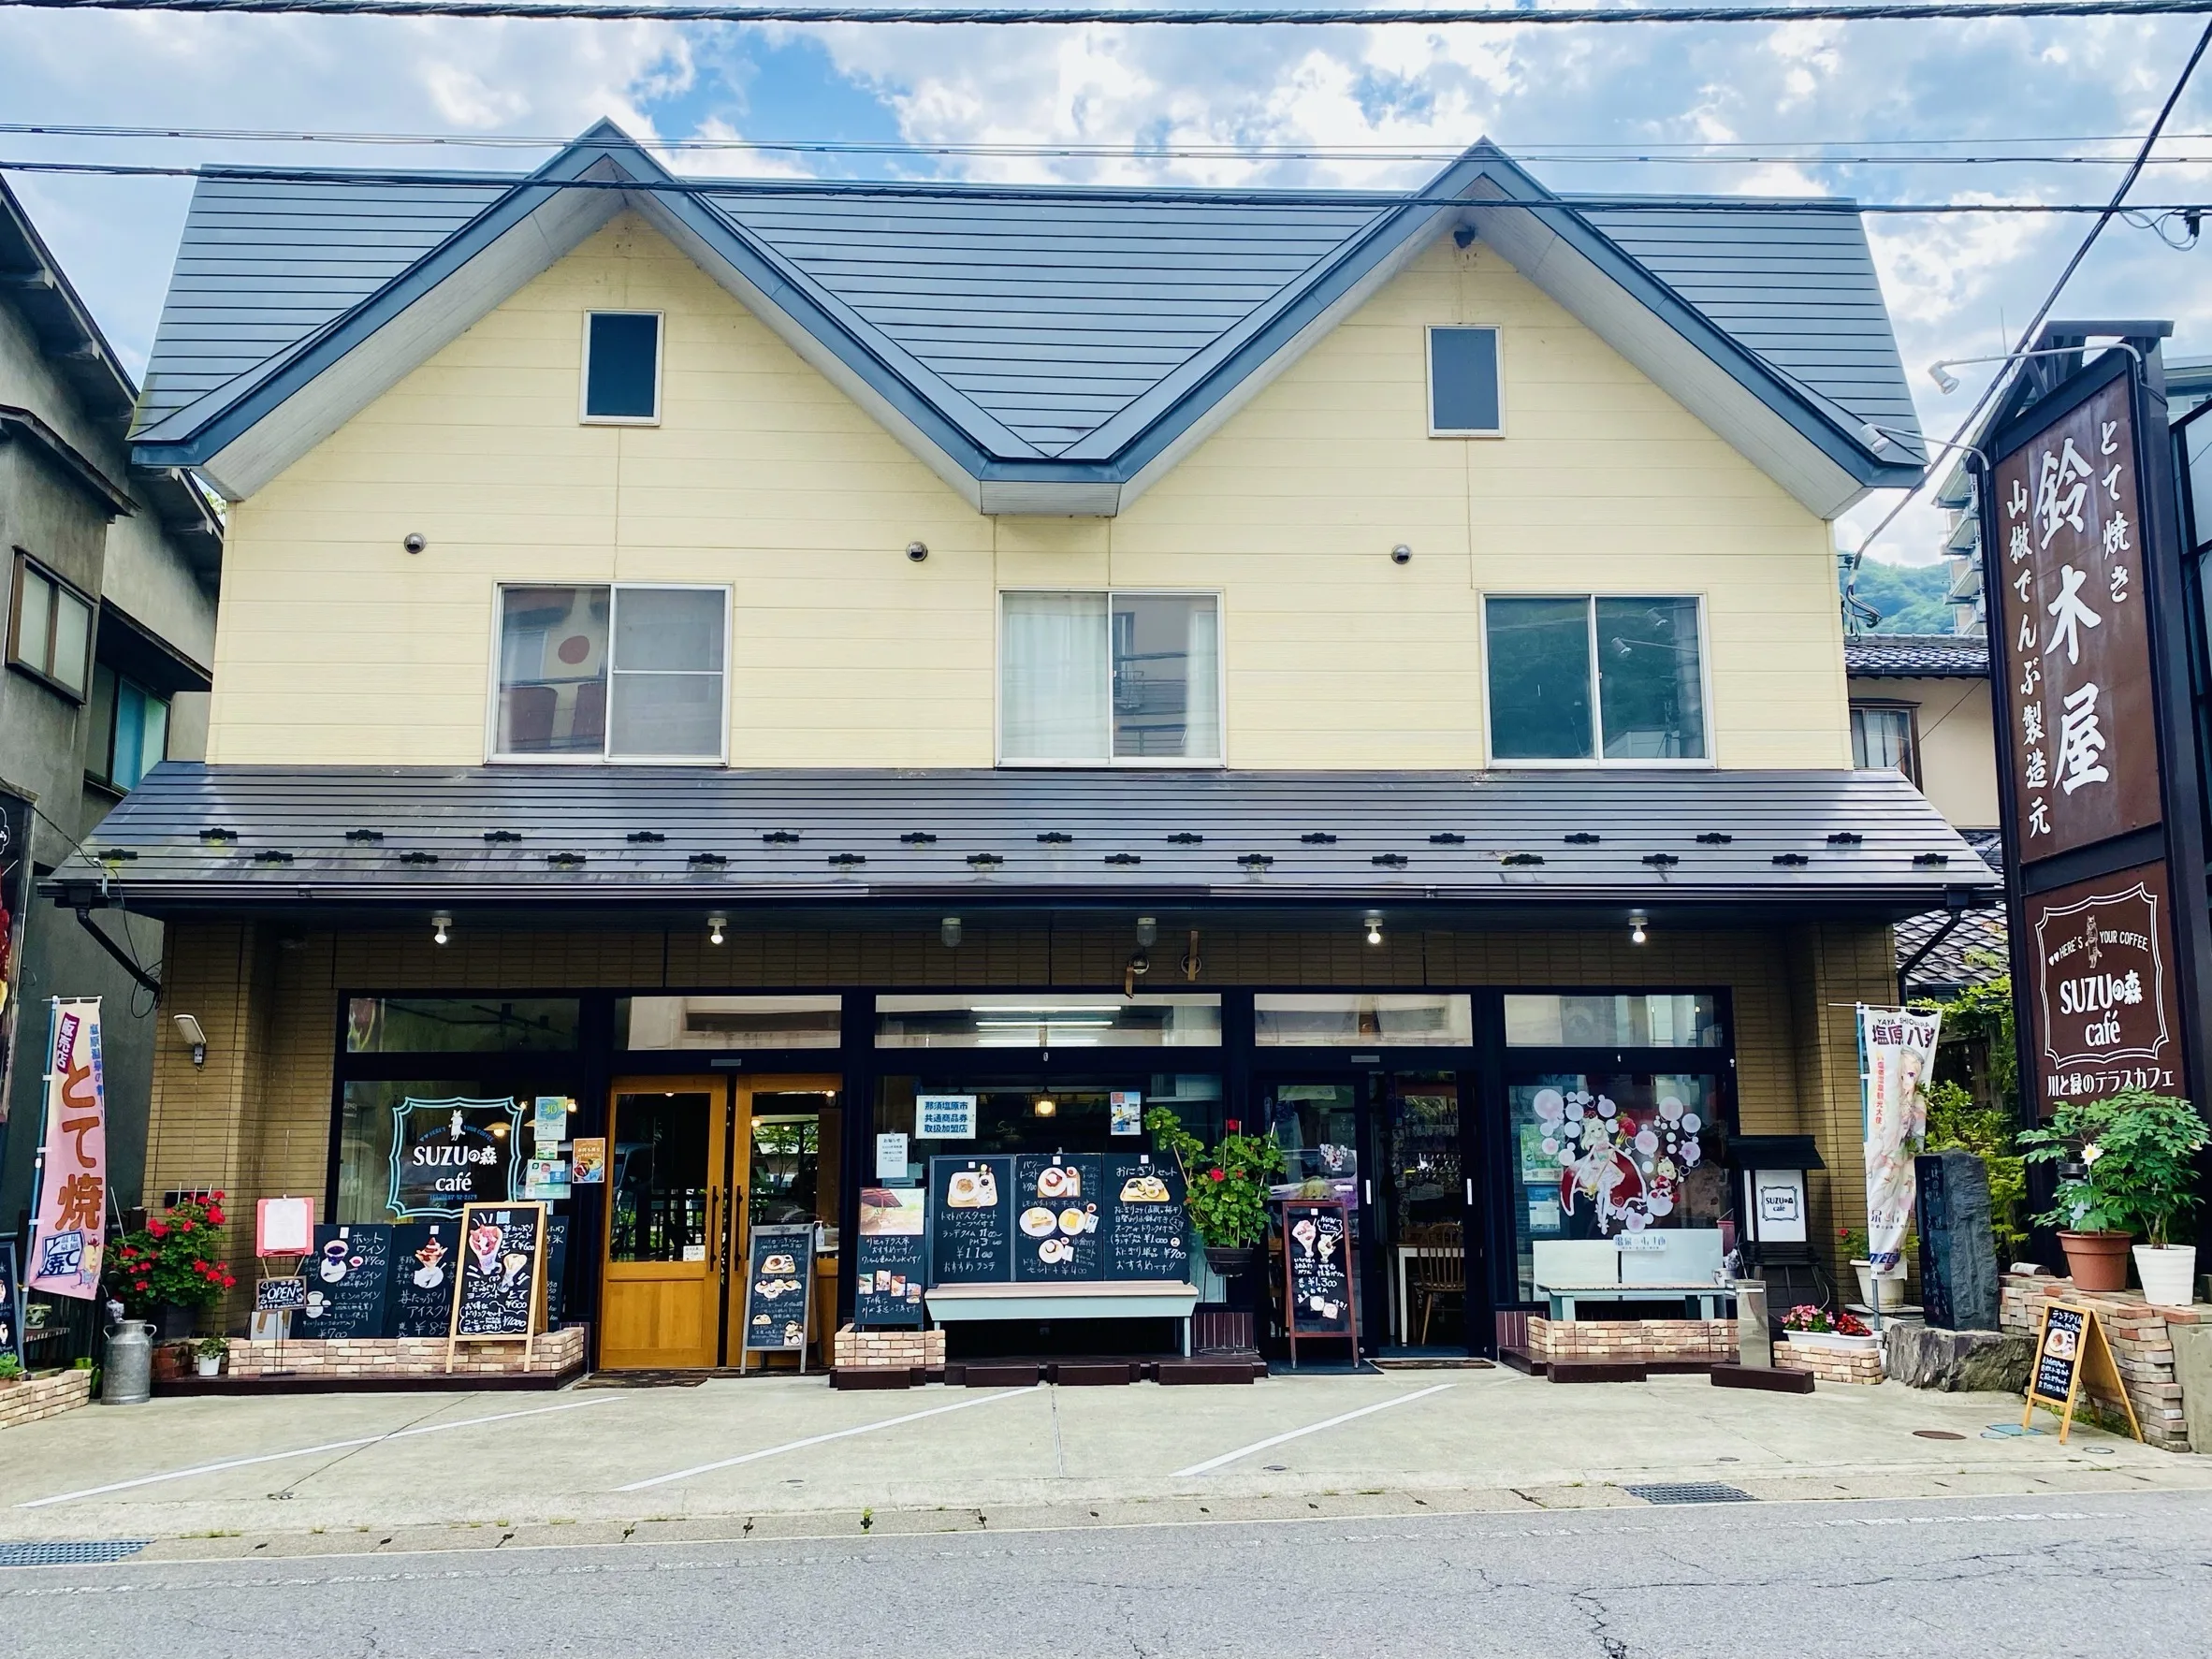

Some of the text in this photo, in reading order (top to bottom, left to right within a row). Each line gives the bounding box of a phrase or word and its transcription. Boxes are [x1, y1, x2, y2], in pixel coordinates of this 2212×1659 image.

[2100, 420, 2132, 604] とて焼き
[2034, 436, 2110, 796] 鈴木屋
[2099, 930, 2117, 944] YOUR
[2085, 1010, 2121, 1047] café
[2047, 1067, 2175, 1097] 川と緑のテラスカフェ
[924, 1101, 968, 1110] 那須塩原市
[924, 1113, 968, 1123] 共通商品券
[924, 1124, 968, 1133] 取扱加盟店
[412, 1145, 498, 1166] SUZUの森
[435, 1171, 473, 1191] café
[353, 1231, 384, 1244] ホット
[357, 1244, 386, 1255] ワイン
[267, 1287, 297, 1299] OPEN
[507, 1290, 529, 1300] とて
[505, 1300, 528, 1309] ¥600
[318, 1328, 348, 1339] ¥700
